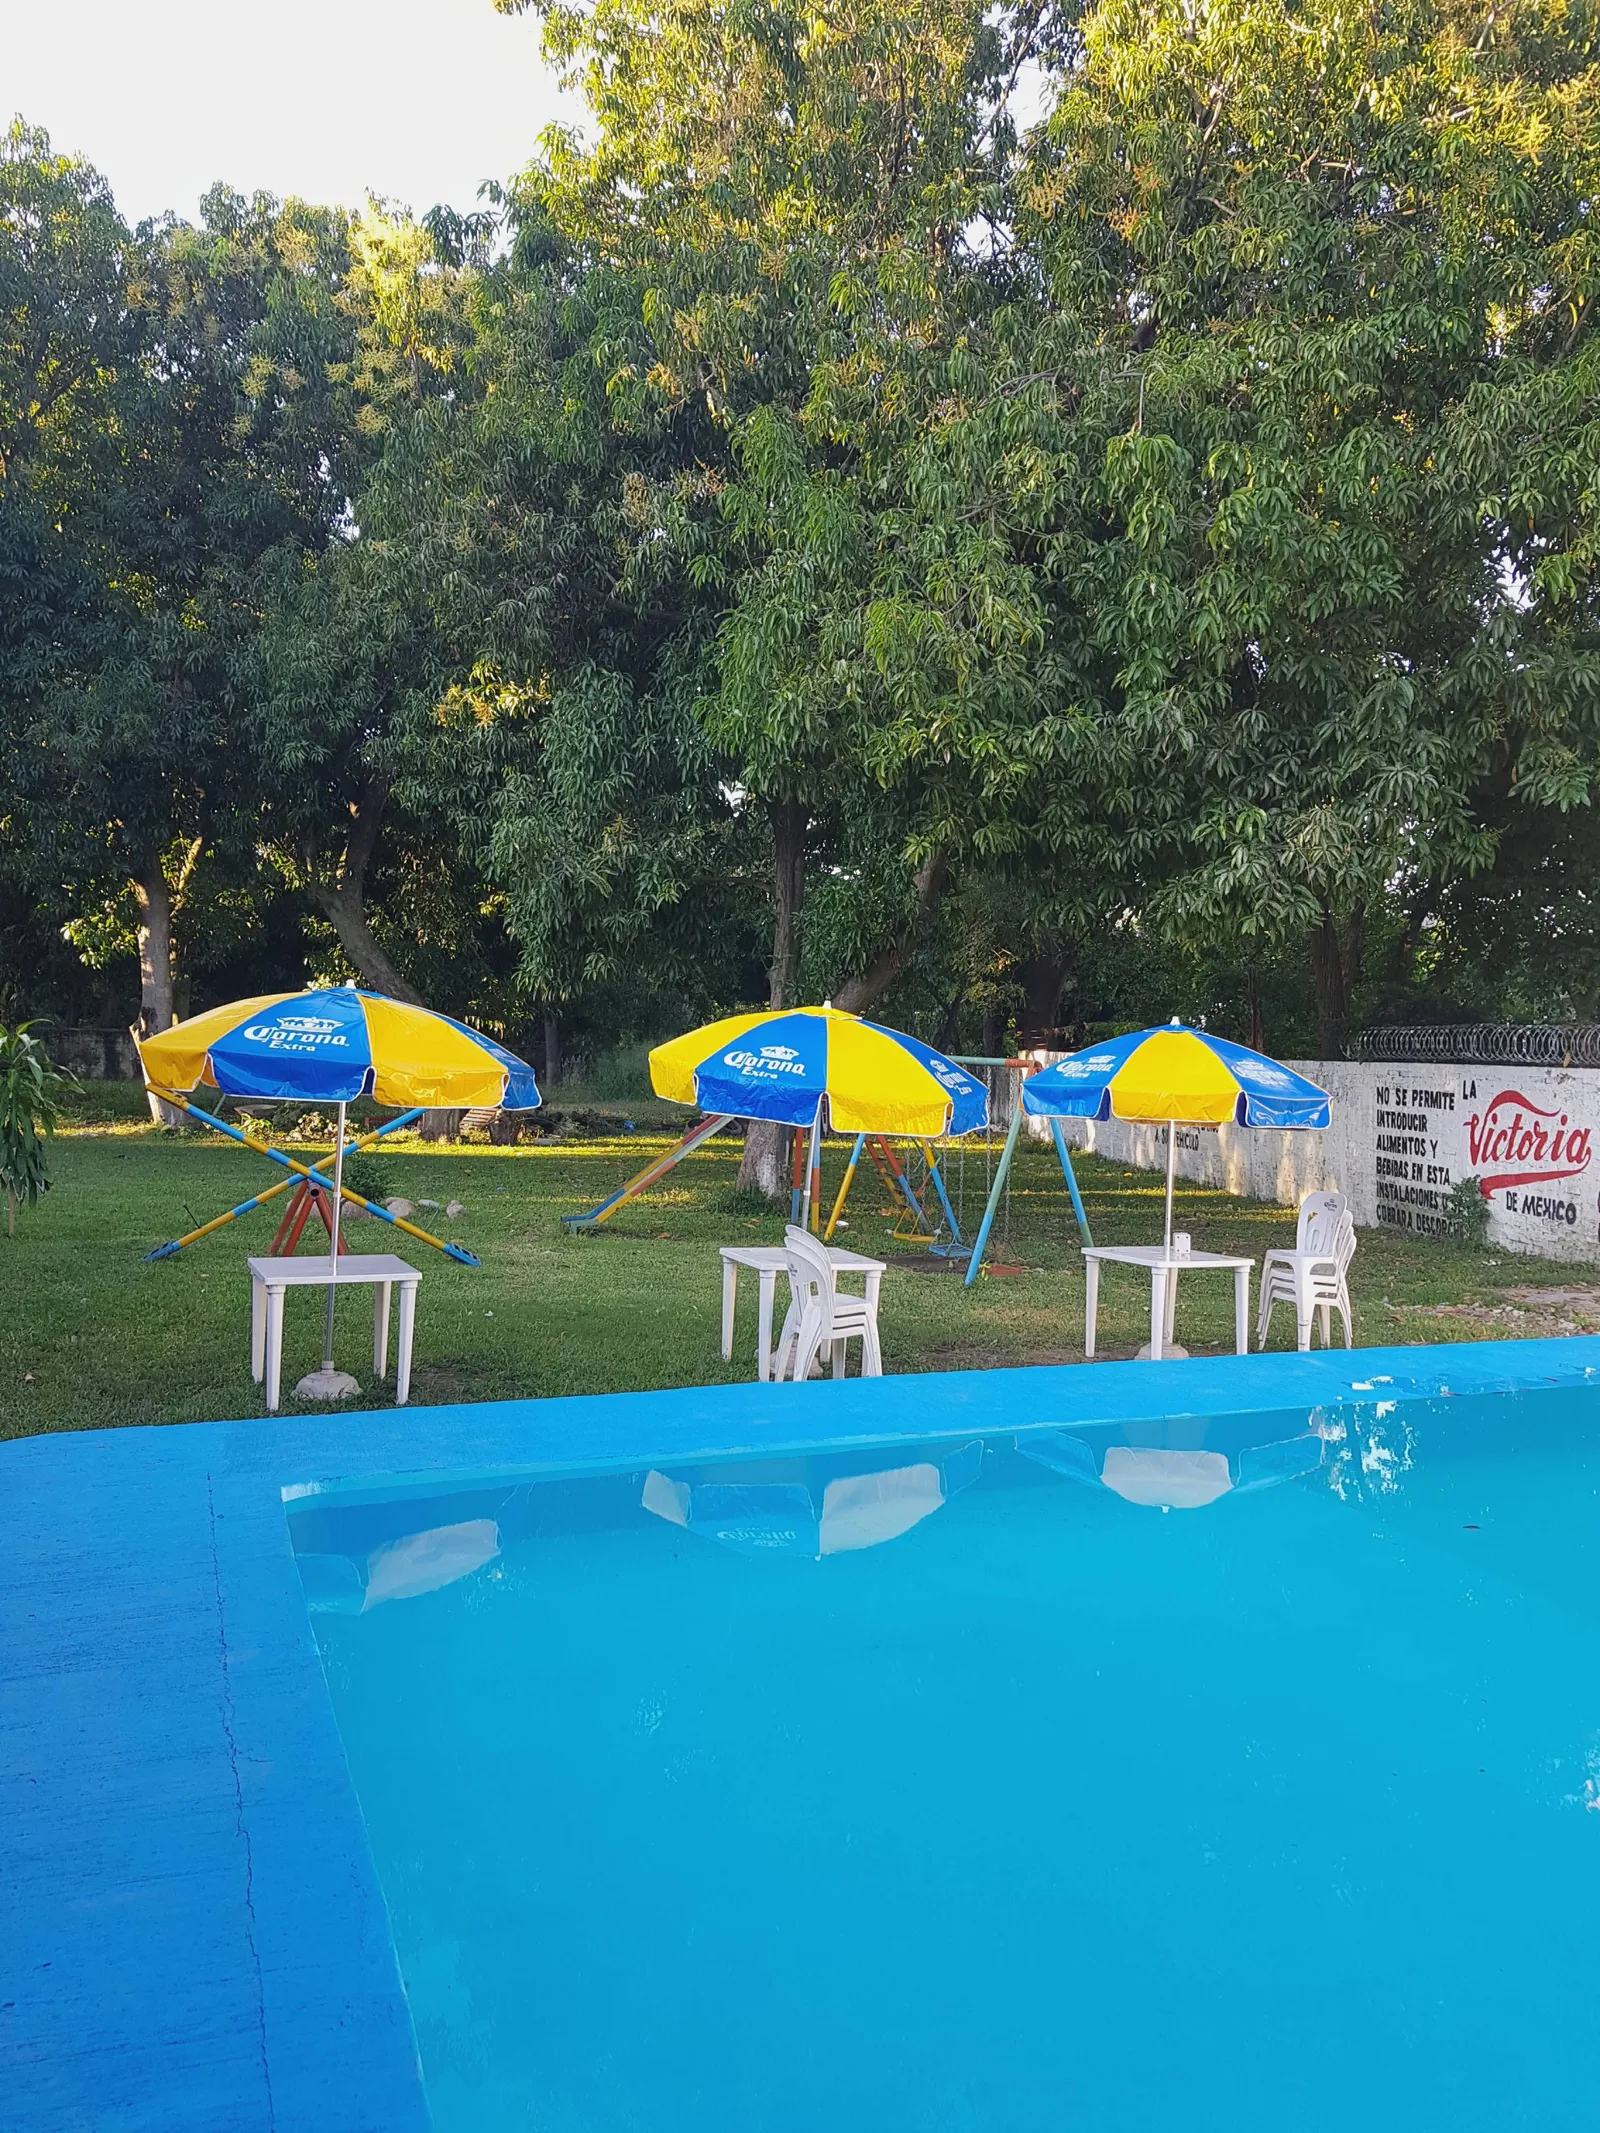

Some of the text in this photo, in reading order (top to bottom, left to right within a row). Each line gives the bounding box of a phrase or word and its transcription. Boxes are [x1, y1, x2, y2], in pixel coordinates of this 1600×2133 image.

[243, 1025, 348, 1046] Corona
[268, 1040, 316, 1052] Extra
[723, 1051, 806, 1076] Corona
[741, 1066, 778, 1079] Extra
[1376, 1086, 1455, 1110] NO SE PERMITE
[1462, 1080, 1477, 1100] LA
[1376, 1109, 1428, 1132] INTRODUCIR
[1463, 1090, 1593, 1167] Victoria
[1173, 1130, 1199, 1151] EHICULO
[1375, 1134, 1438, 1159] ALIMENTOS Y
[1376, 1156, 1450, 1186] BEBIDAS EN ESTA
[1376, 1180, 1439, 1210] INSTALACIONES
[1506, 1190, 1518, 1213] DE
[1522, 1195, 1577, 1225] MEXICO
[1376, 1204, 1462, 1238] COBRARA DESCORCH
